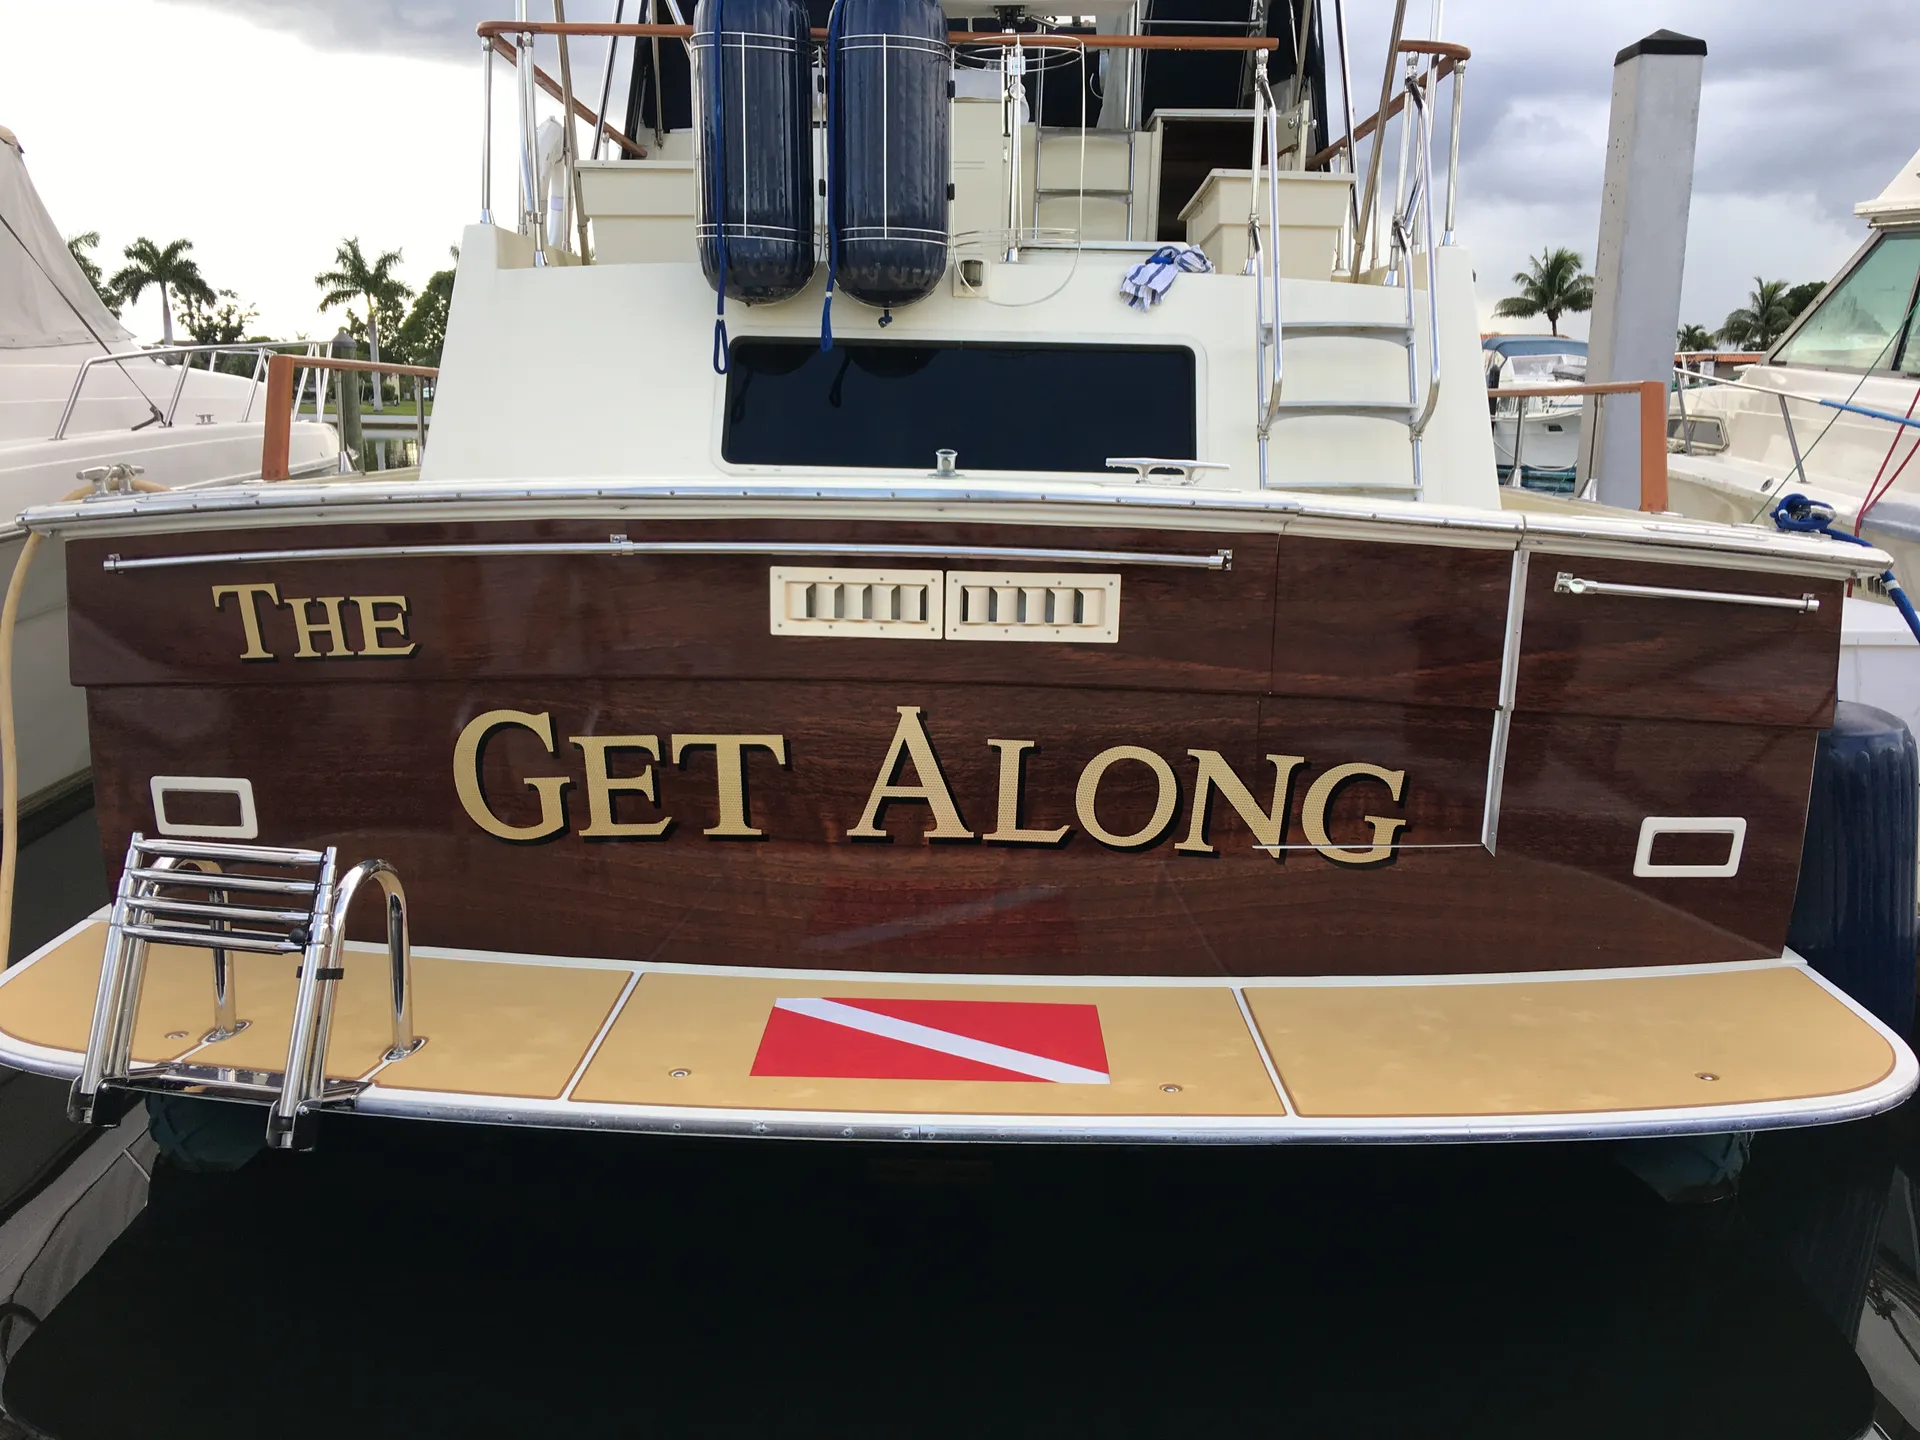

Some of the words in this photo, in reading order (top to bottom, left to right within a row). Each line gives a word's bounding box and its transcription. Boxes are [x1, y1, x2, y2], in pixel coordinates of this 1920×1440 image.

[212, 582, 418, 661] THE
[453, 708, 788, 843] GET
[847, 705, 1409, 866] ALONG
